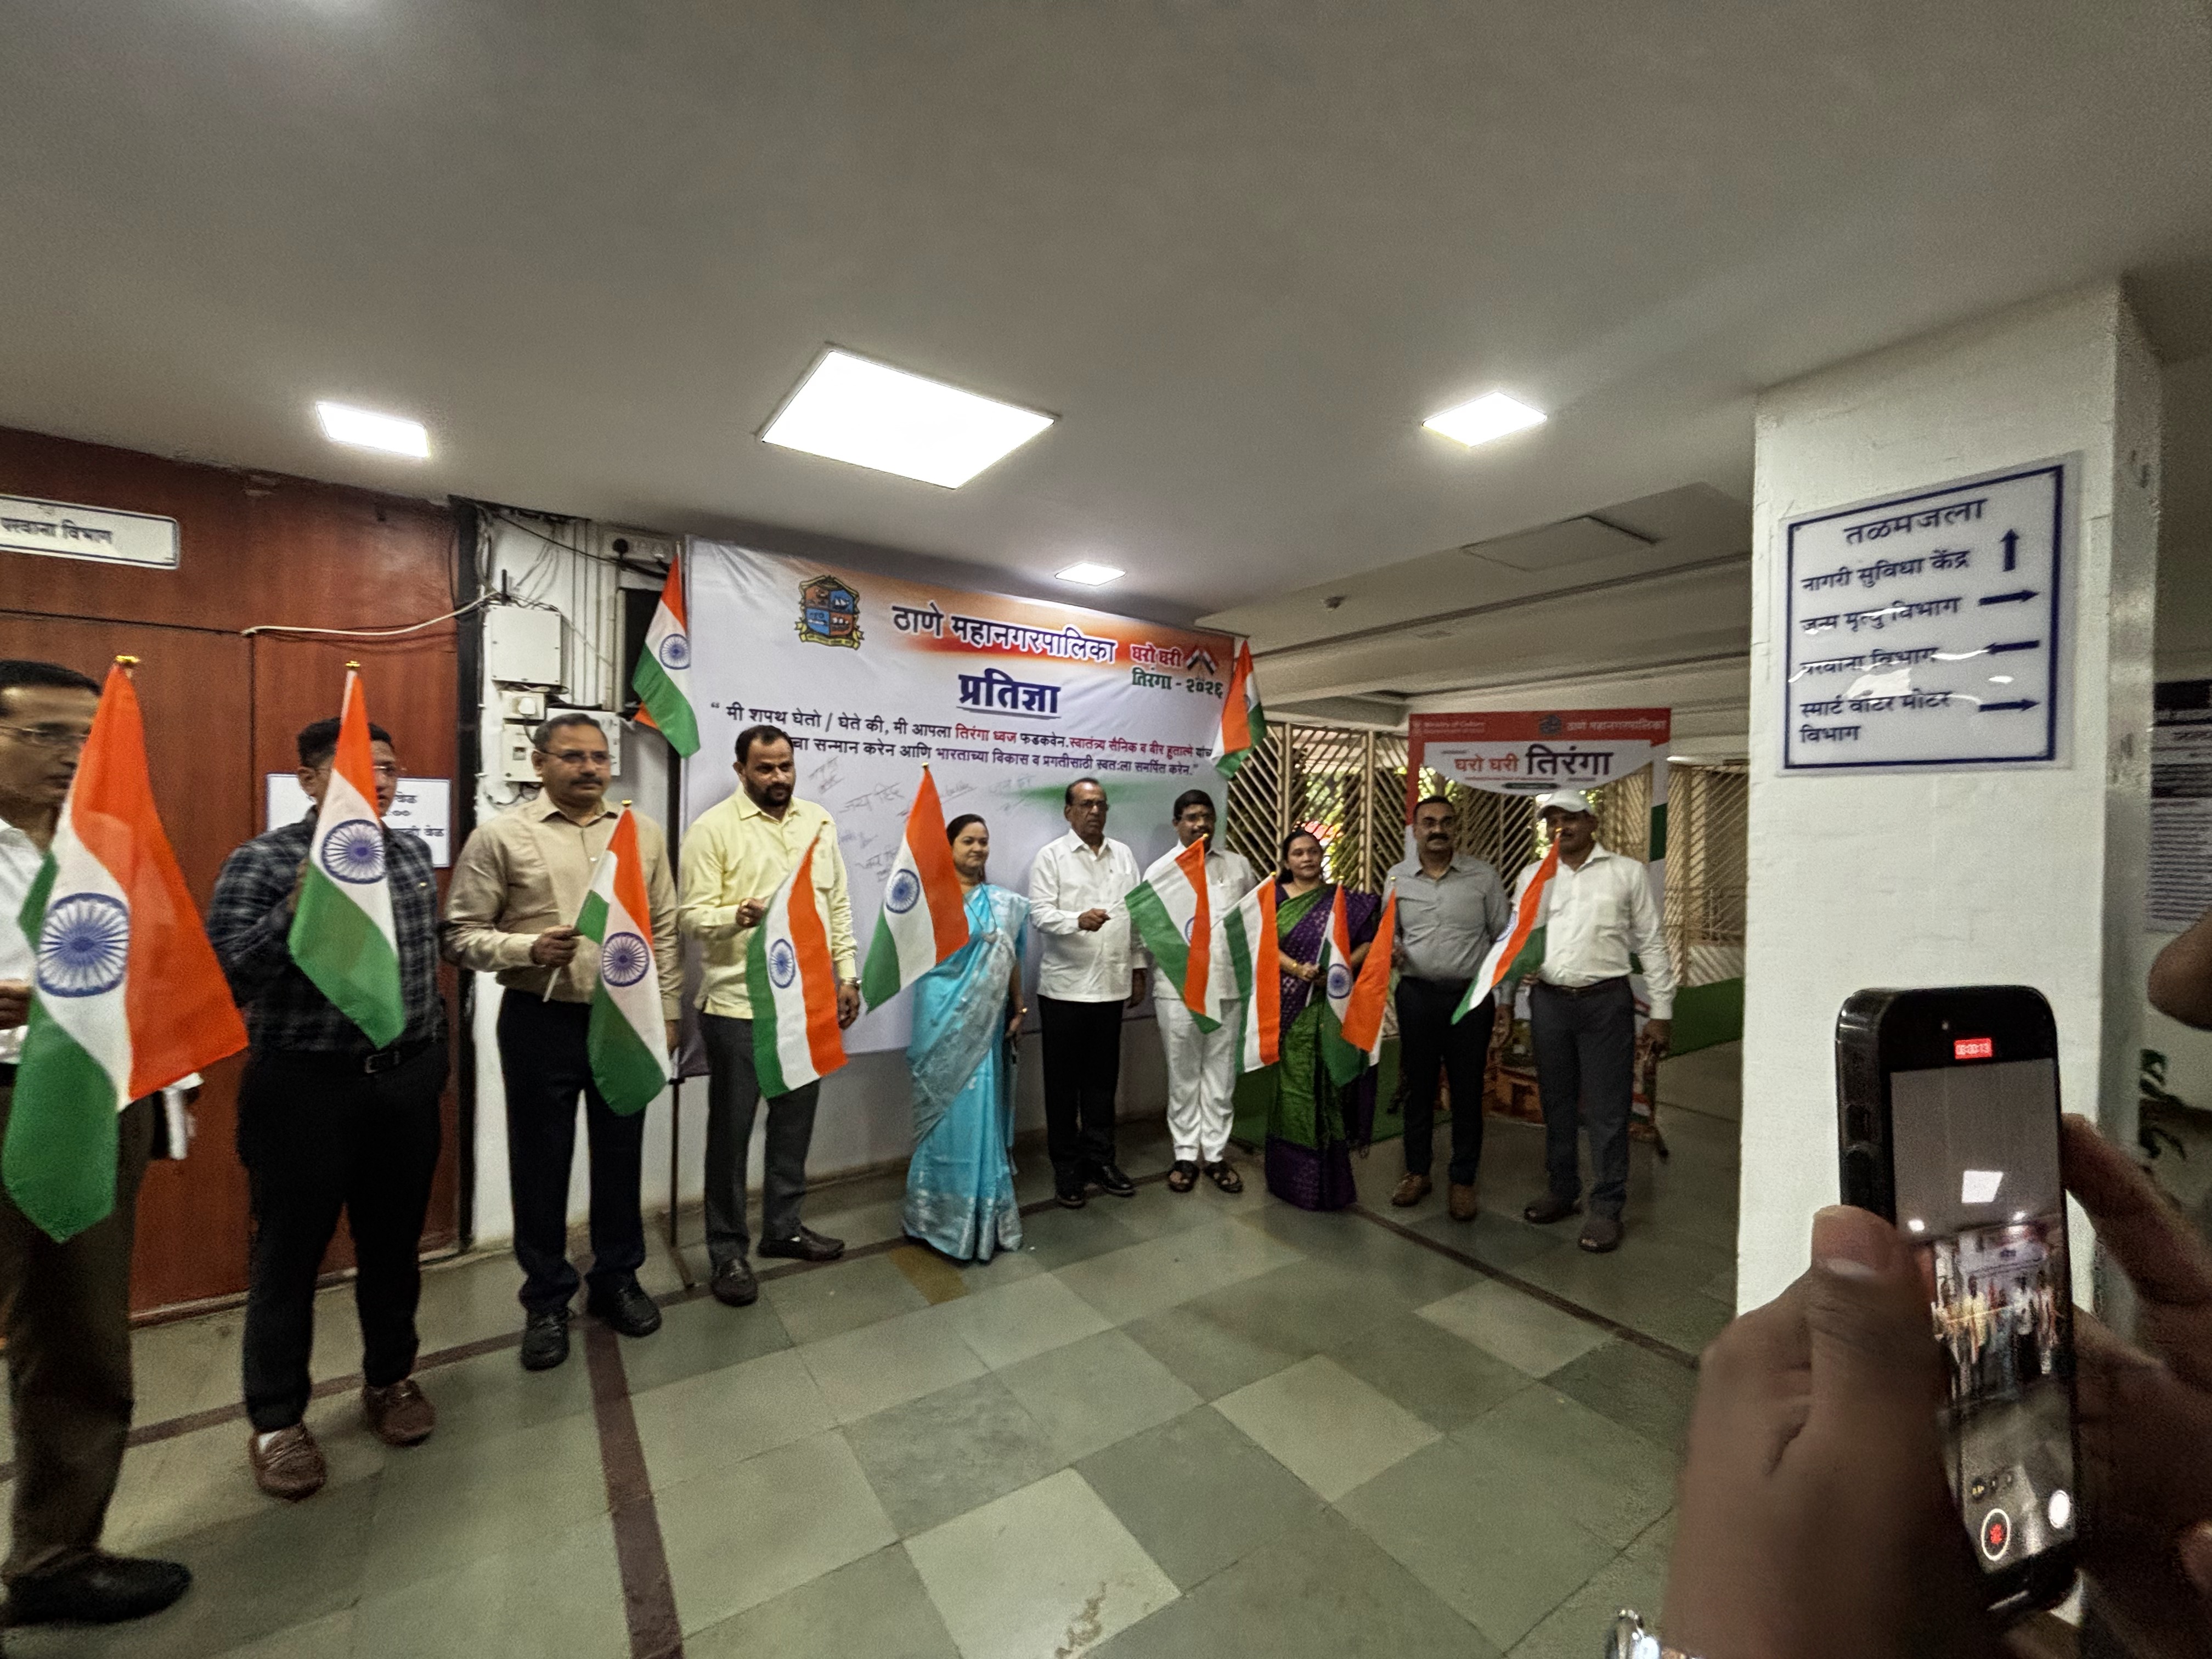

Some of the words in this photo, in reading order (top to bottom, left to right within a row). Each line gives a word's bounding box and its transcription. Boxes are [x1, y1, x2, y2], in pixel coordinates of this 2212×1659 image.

[1843, 498, 1988, 544] तळमजला
[1801, 566, 1853, 591] नागरी
[1857, 560, 1926, 588] सुविधा
[1929, 549, 1971, 569] केंद्र
[893, 602, 944, 637] ठाणे
[951, 615, 1116, 663] महानगरपालिका
[958, 668, 1062, 714] प्रतिज्ञा
[1132, 667, 1172, 690] तिरंगा
[726, 702, 744, 721] मी
[748, 709, 788, 724] शपथ
[792, 708, 821, 727] घेतो
[838, 712, 861, 730] घेते
[893, 718, 908, 735] मी
[912, 723, 952, 738] आपला
[955, 723, 990, 741] तिरंगा
[1799, 724, 1861, 743] विभाग
[814, 738, 860, 754] सन्मान
[863, 738, 896, 756] करेन
[900, 741, 932, 759] आणि
[936, 748, 989, 763] भारताच्या
[992, 748, 1029, 766] विकास
[1525, 743, 1615, 775] तिरंगा
